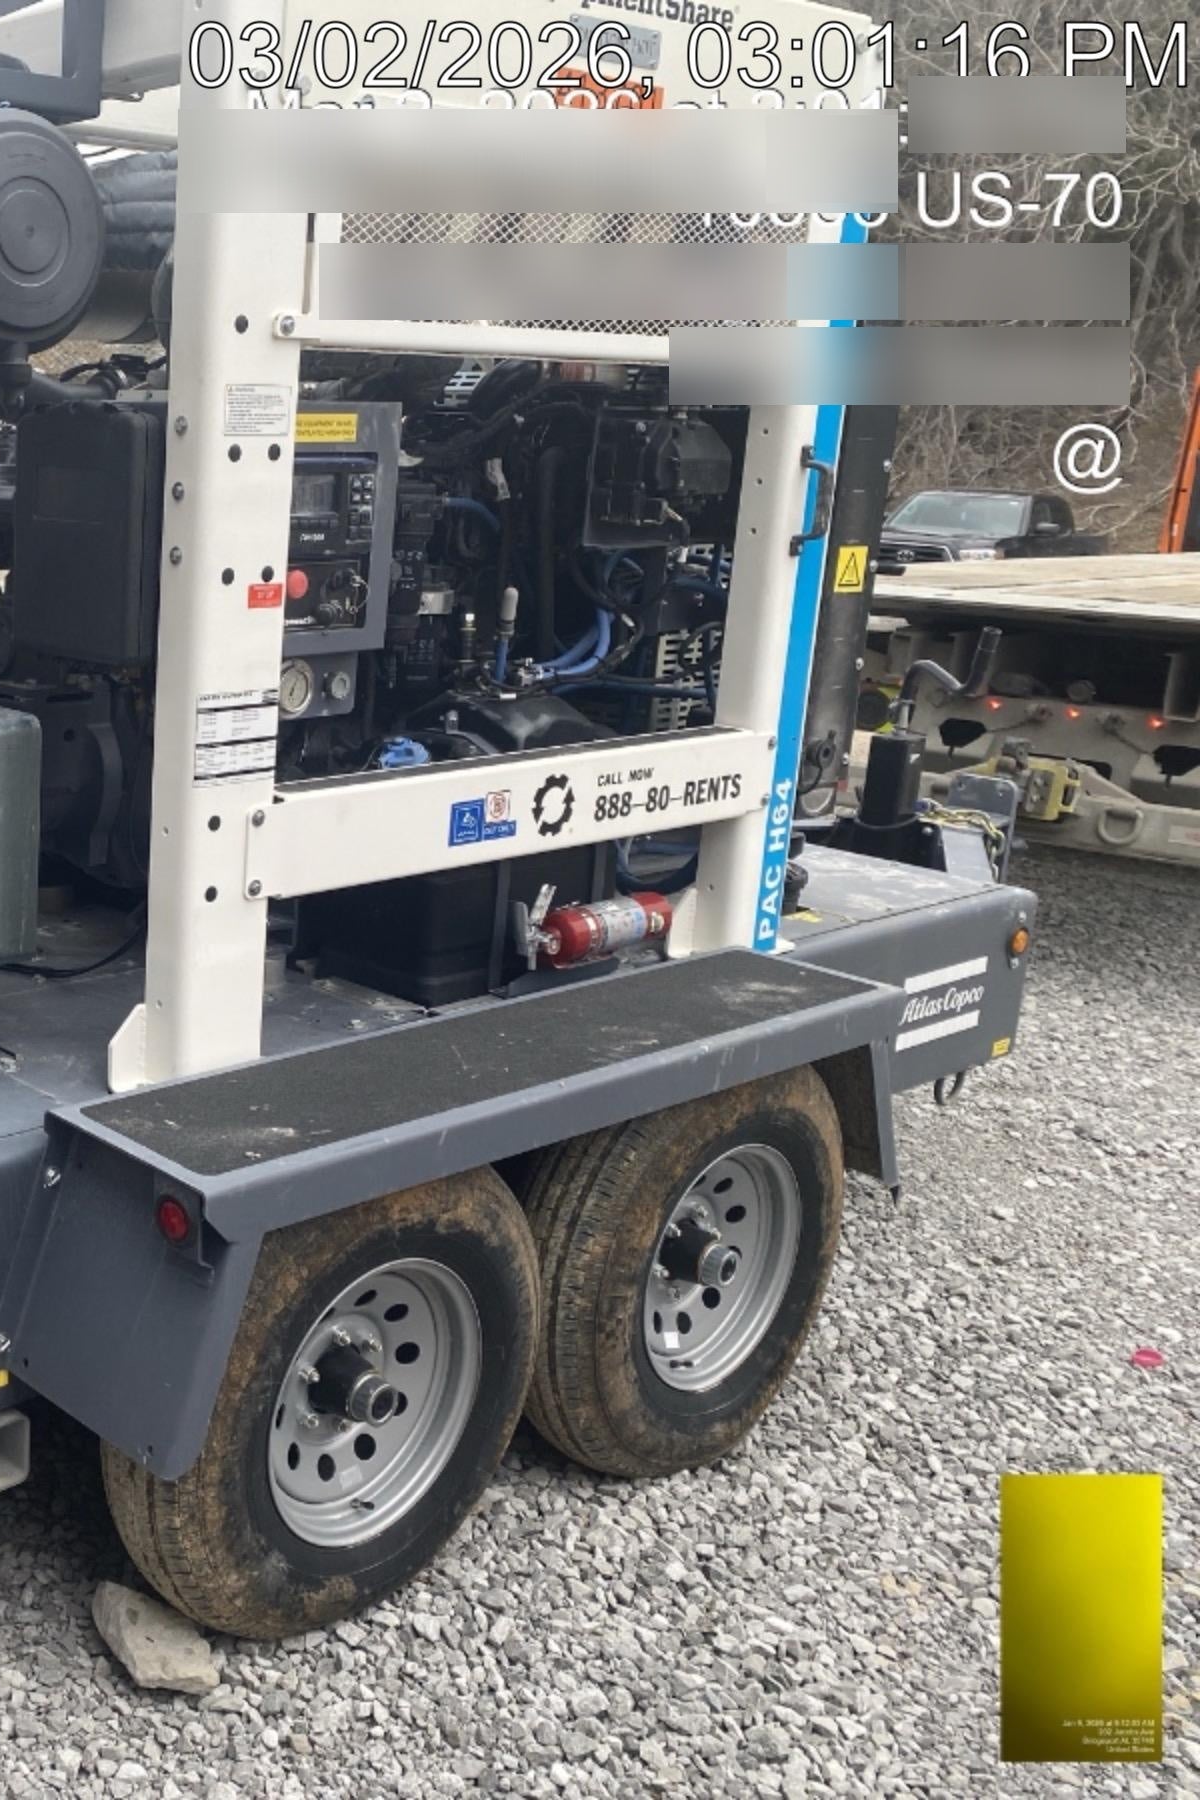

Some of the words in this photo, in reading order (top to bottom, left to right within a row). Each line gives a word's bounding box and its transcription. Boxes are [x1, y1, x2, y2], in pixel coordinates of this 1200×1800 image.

[594, 773, 742, 822] 888-80-RENTS
[597, 771, 624, 787] CALL
[628, 767, 655, 783] NOW
[768, 777, 793, 854] H64
[757, 863, 782, 941] PAC
